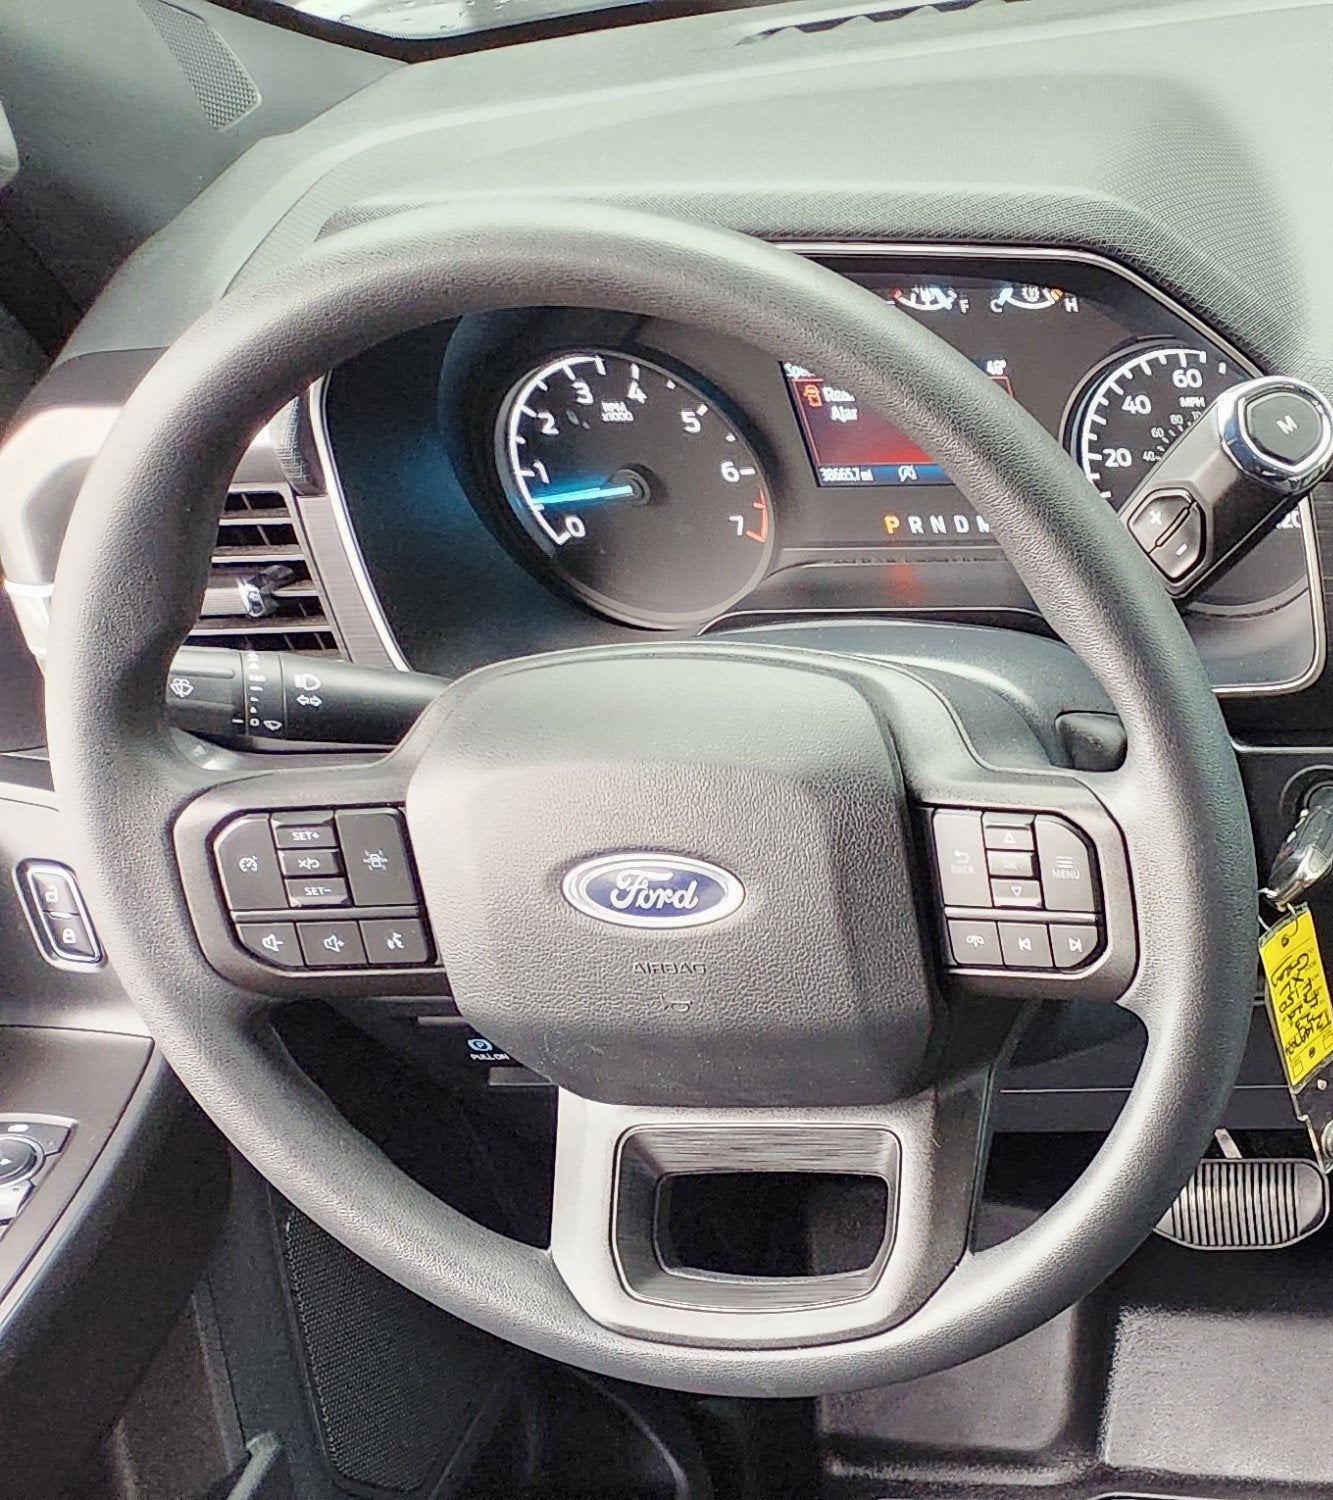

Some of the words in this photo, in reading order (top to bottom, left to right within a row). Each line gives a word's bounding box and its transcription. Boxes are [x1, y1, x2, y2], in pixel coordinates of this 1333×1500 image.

[1064, 296, 1080, 313] H
[1172, 368, 1203, 388] 60
[570, 379, 594, 406] 3
[626, 379, 648, 405] 4
[1178, 396, 1206, 408] MPH
[1121, 394, 1152, 416] 40
[535, 410, 560, 436] 2
[680, 410, 702, 435] 5
[1276, 413, 1299, 435] M
[1102, 447, 1132, 468] 20
[533, 460, 550, 484] 1
[721, 460, 740, 484] 6
[565, 514, 587, 539] 0
[728, 515, 745, 537] 7
[884, 514, 900, 534] P
[907, 515, 925, 534] R
[929, 515, 947, 534] N
[953, 514, 970, 533] D
[1052, 868, 1080, 880] MENU
[610, 869, 699, 909] Ford
[634, 962, 707, 974] AIRBAG
